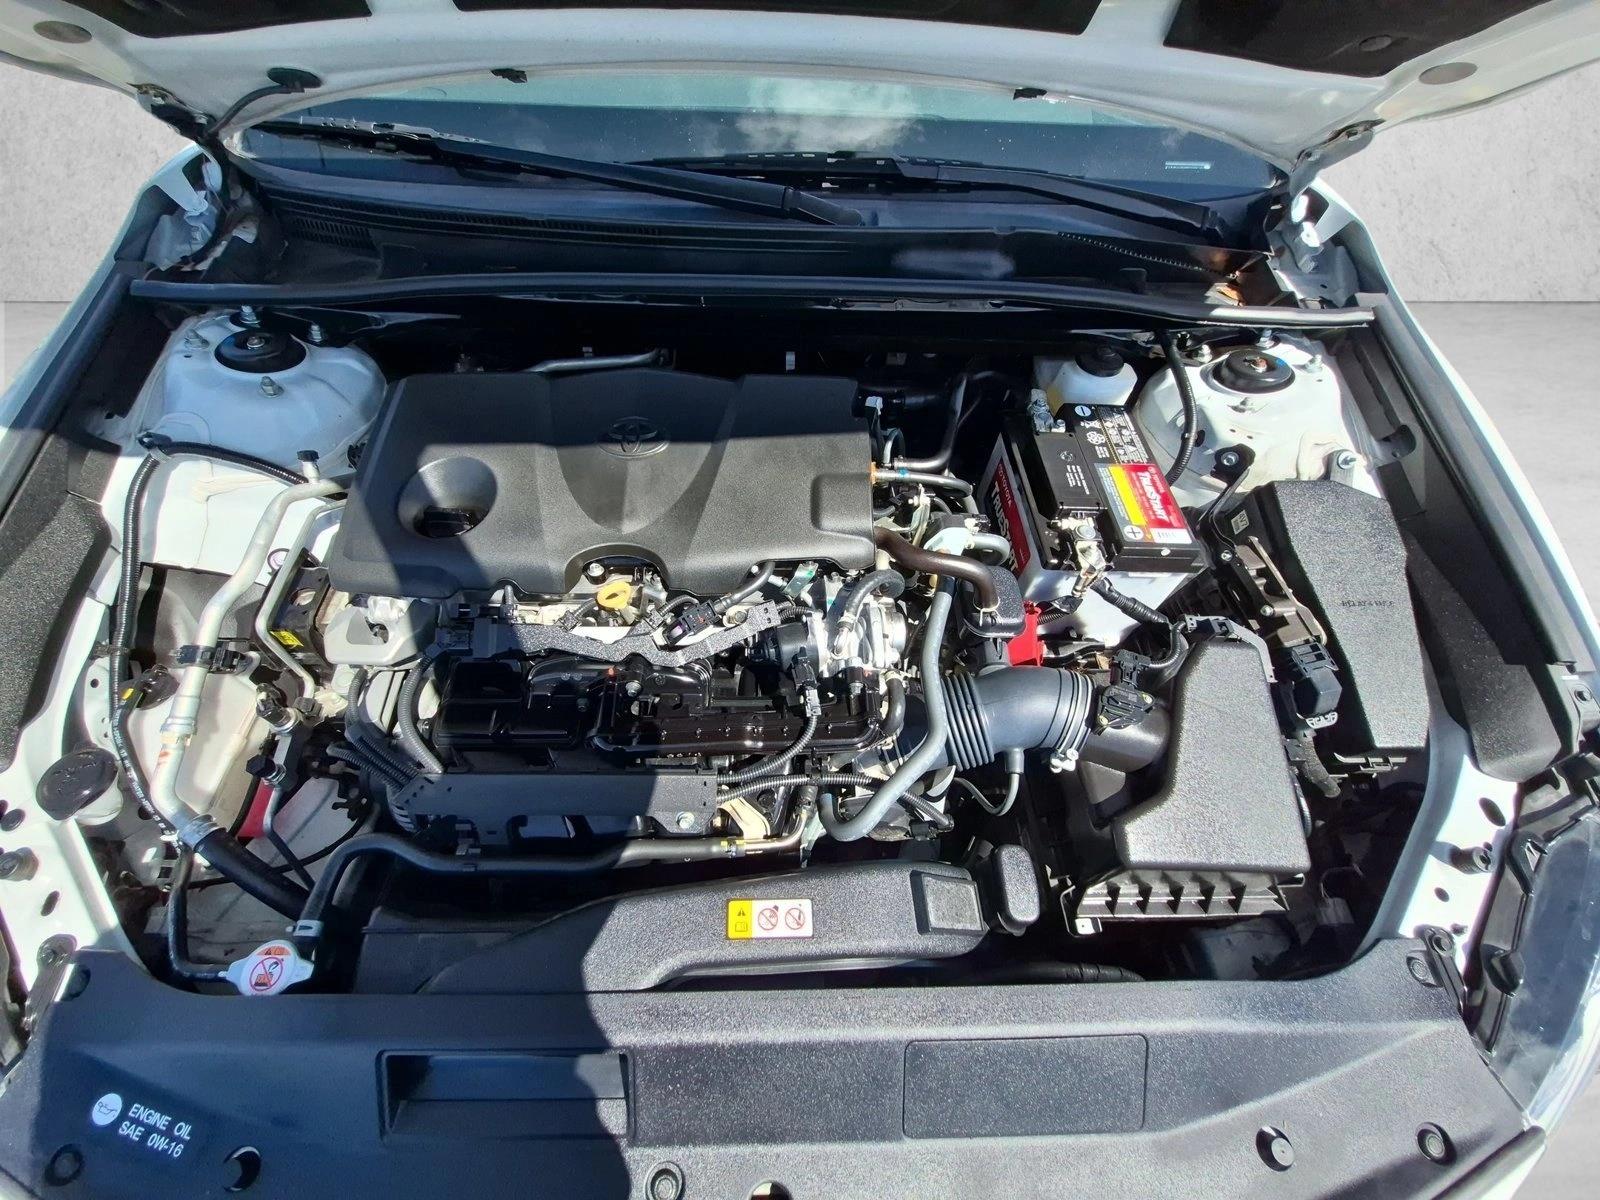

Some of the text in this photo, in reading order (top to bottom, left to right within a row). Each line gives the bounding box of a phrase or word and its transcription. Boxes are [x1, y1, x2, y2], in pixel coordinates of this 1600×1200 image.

[118, 1120, 185, 1158] SAE 0W-16
[128, 1103, 192, 1140] ENGINE OIL
